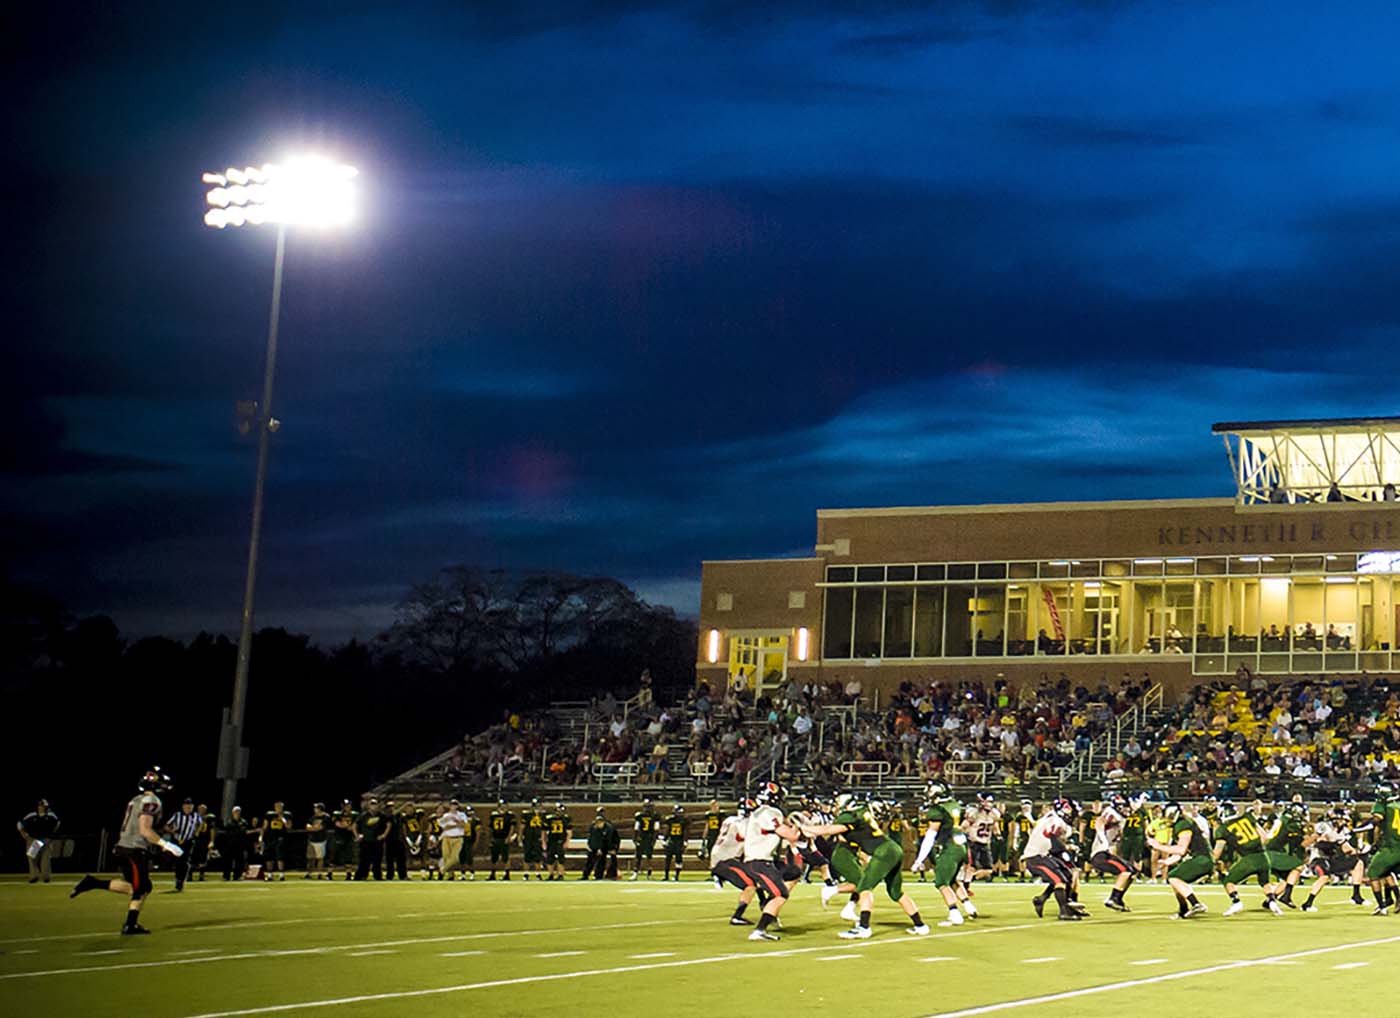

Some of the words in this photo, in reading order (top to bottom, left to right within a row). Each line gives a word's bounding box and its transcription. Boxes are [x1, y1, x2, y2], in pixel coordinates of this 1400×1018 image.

[1158, 521, 1297, 544] KENNETH
[1126, 816, 1141, 828] 72
[1227, 818, 1259, 845] 30
